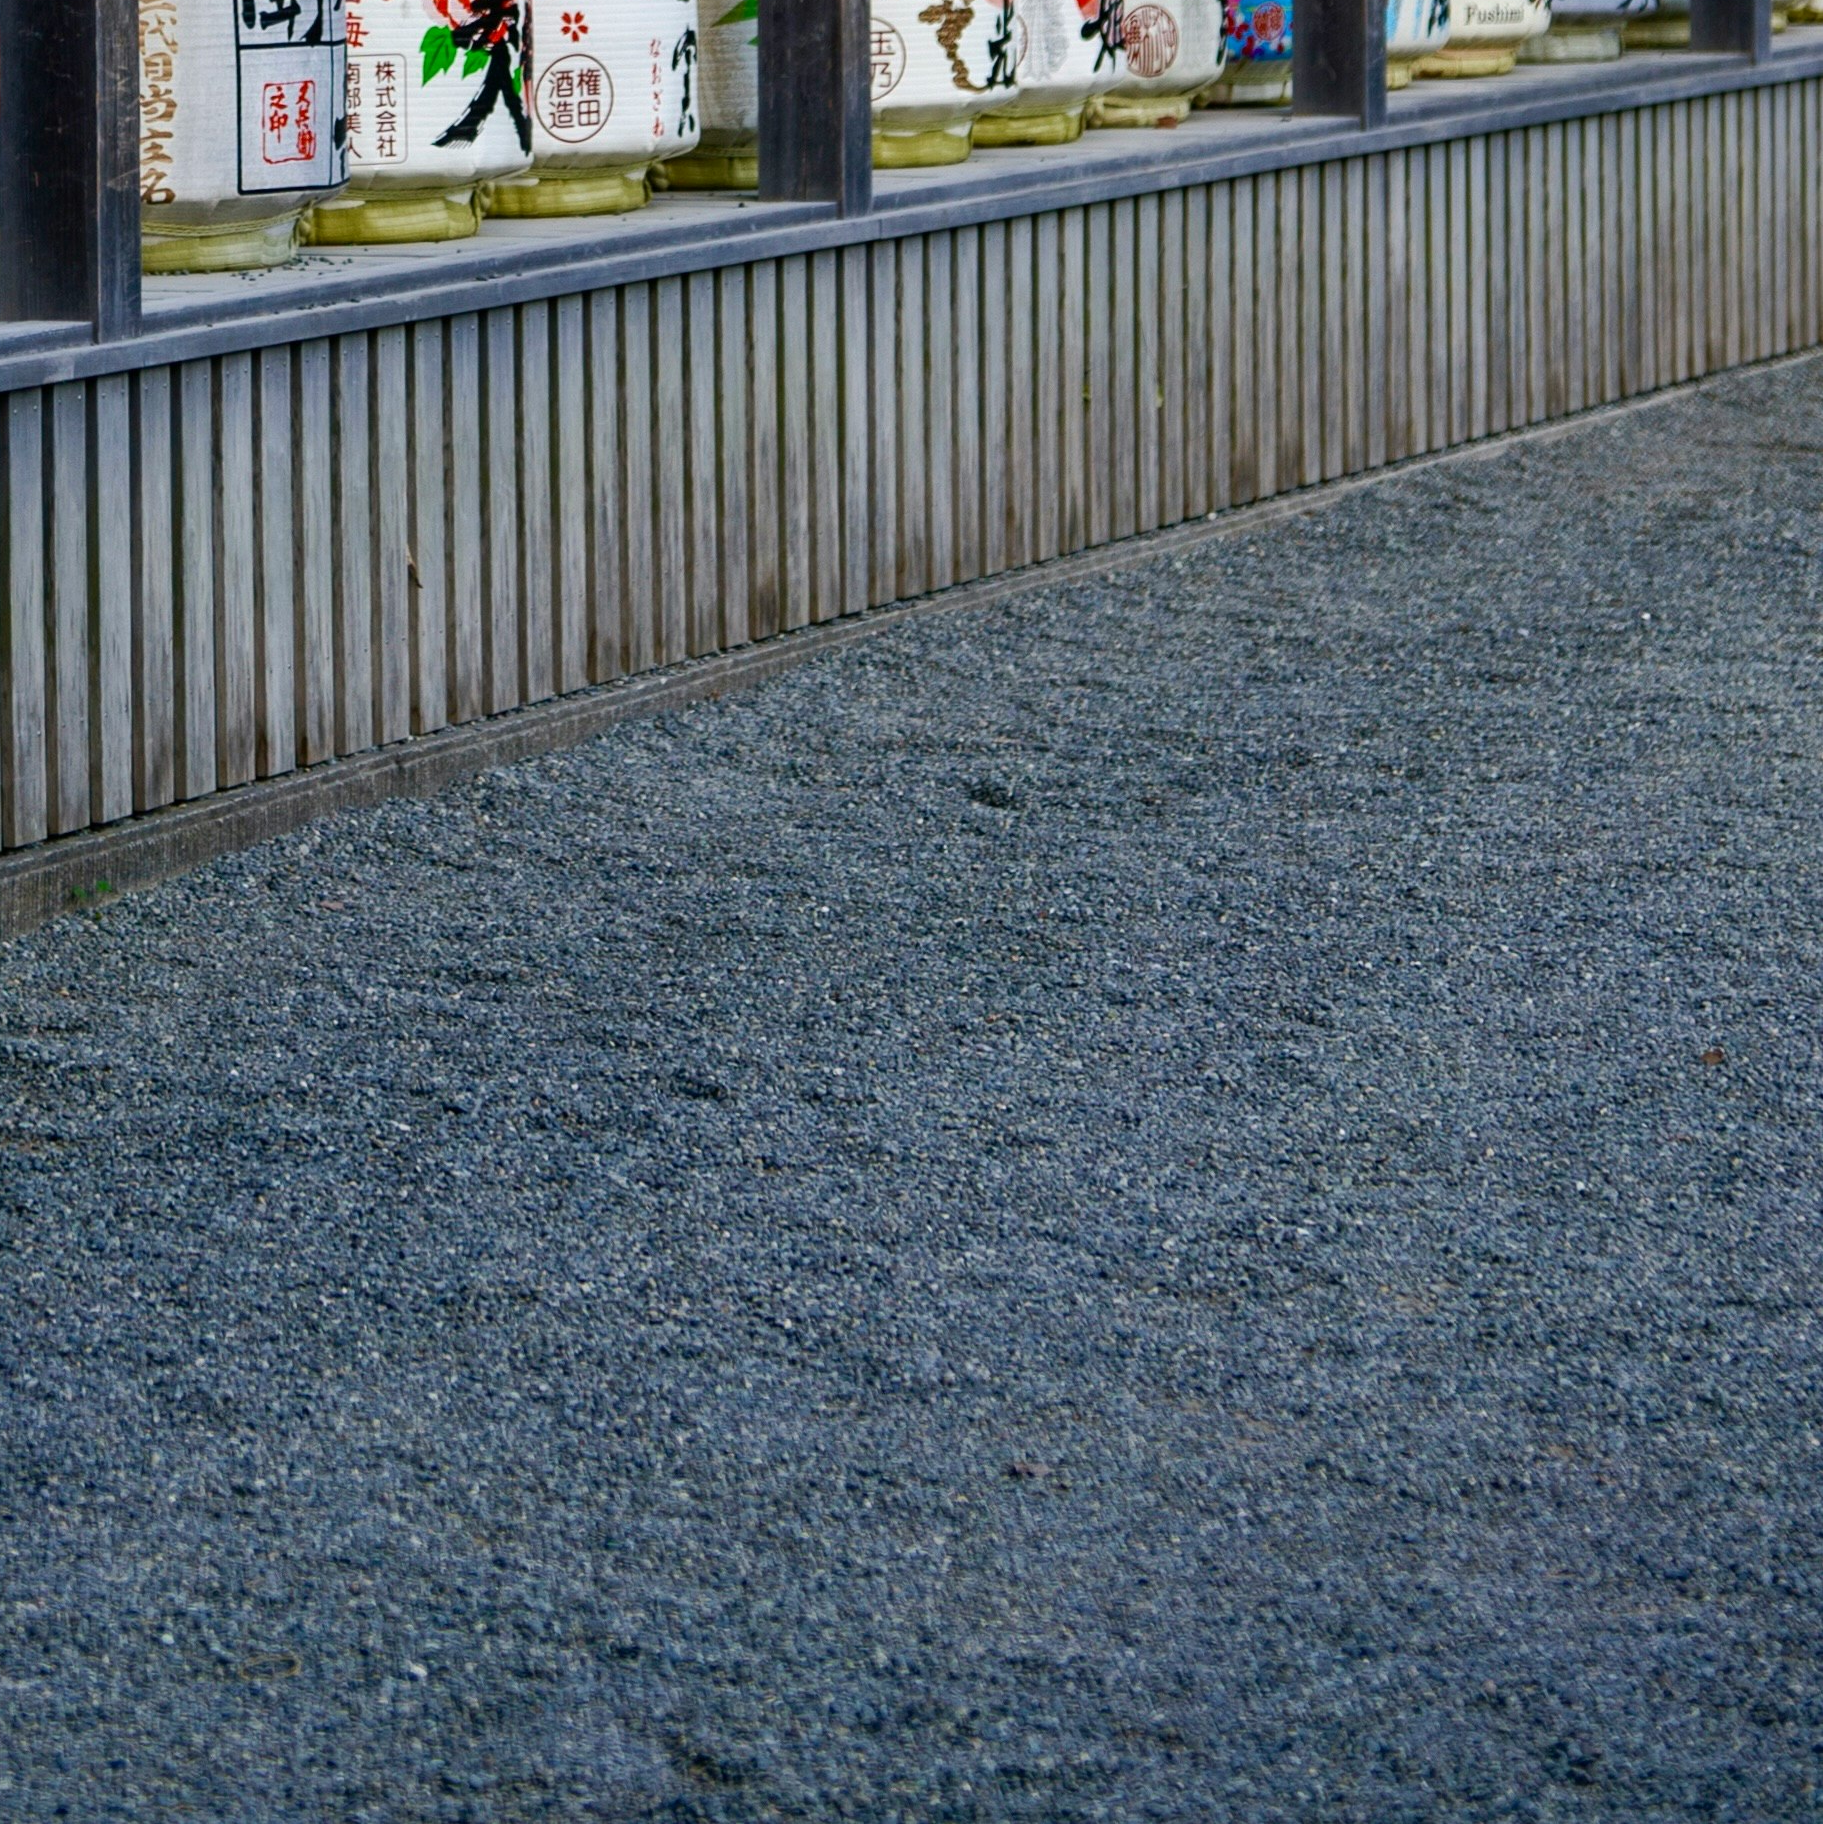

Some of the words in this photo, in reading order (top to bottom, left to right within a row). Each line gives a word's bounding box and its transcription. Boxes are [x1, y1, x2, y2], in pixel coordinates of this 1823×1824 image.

[1463, 3, 1525, 27] Fushimi
[375, 60, 399, 159] 株式会社
